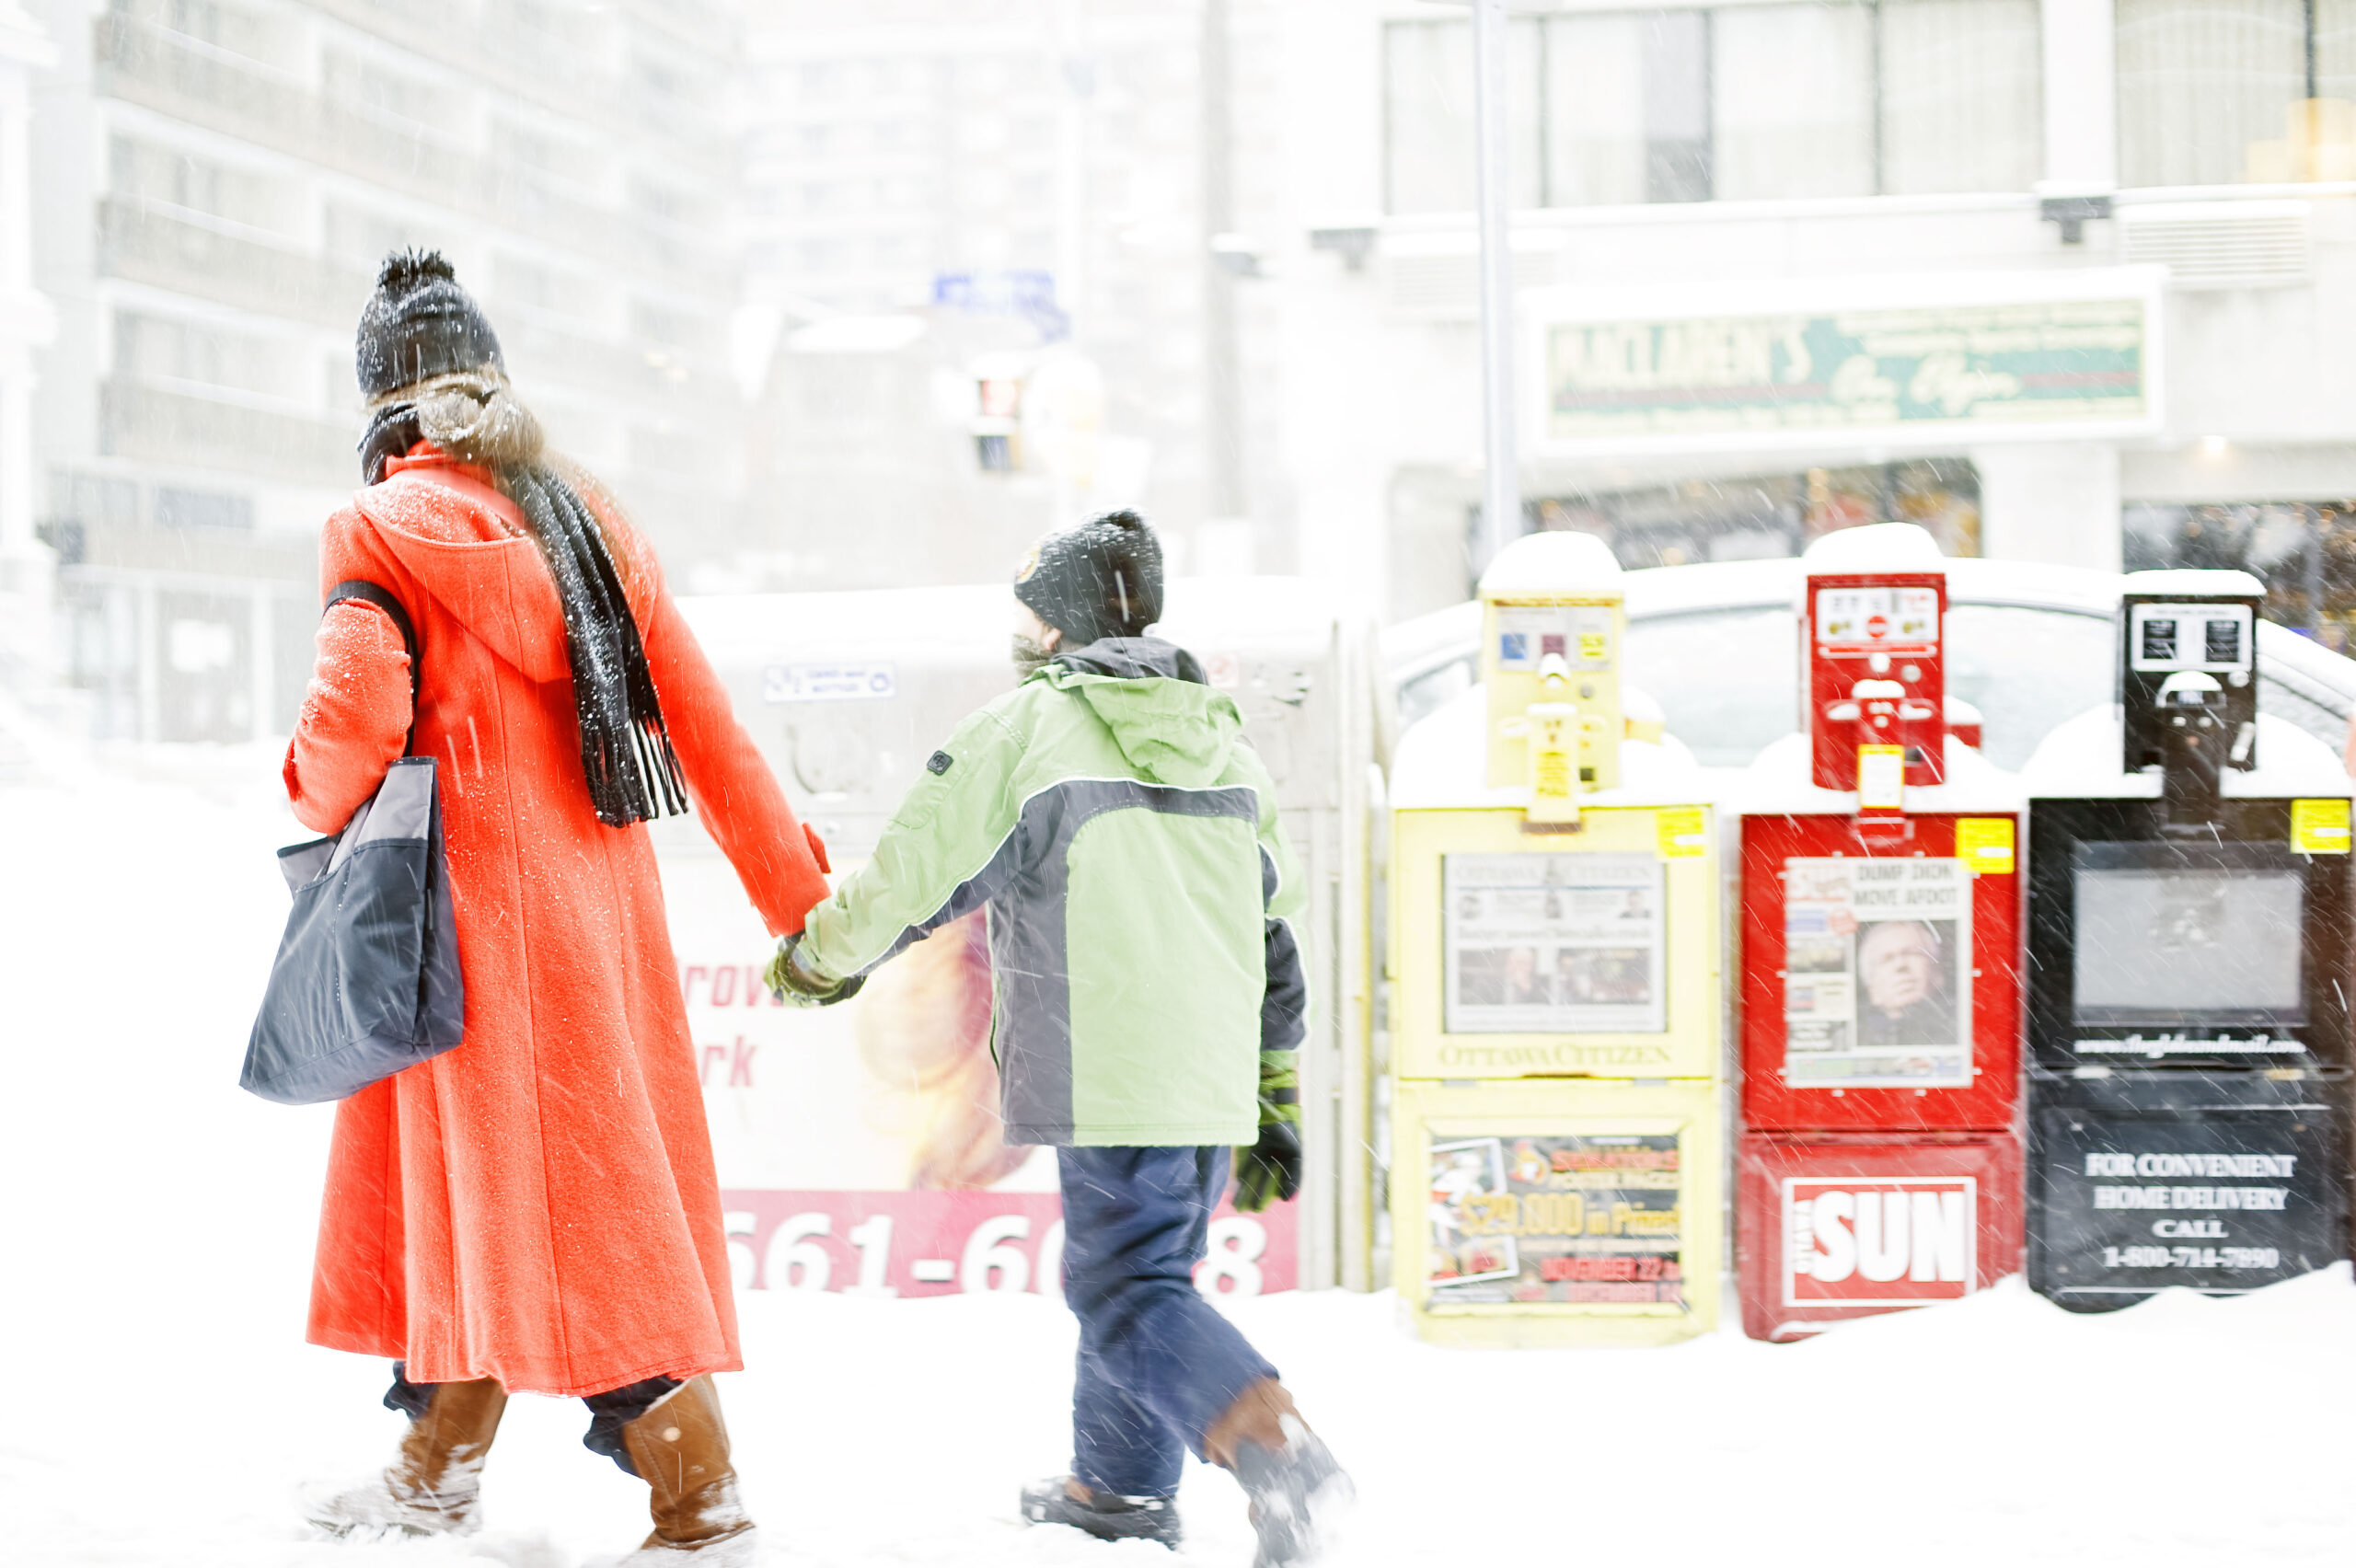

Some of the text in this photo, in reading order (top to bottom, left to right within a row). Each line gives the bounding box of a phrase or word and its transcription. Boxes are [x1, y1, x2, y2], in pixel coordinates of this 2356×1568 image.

[701, 1034, 758, 1088] rk
[1553, 1042, 1672, 1066] CITIZEN
[2085, 1152, 2298, 1178] FOR CONVENIENT
[2093, 1185, 2290, 1211] HOME DELIVERY
[1811, 1190, 1967, 1283] SUN
[2151, 1218, 2230, 1239] CALL
